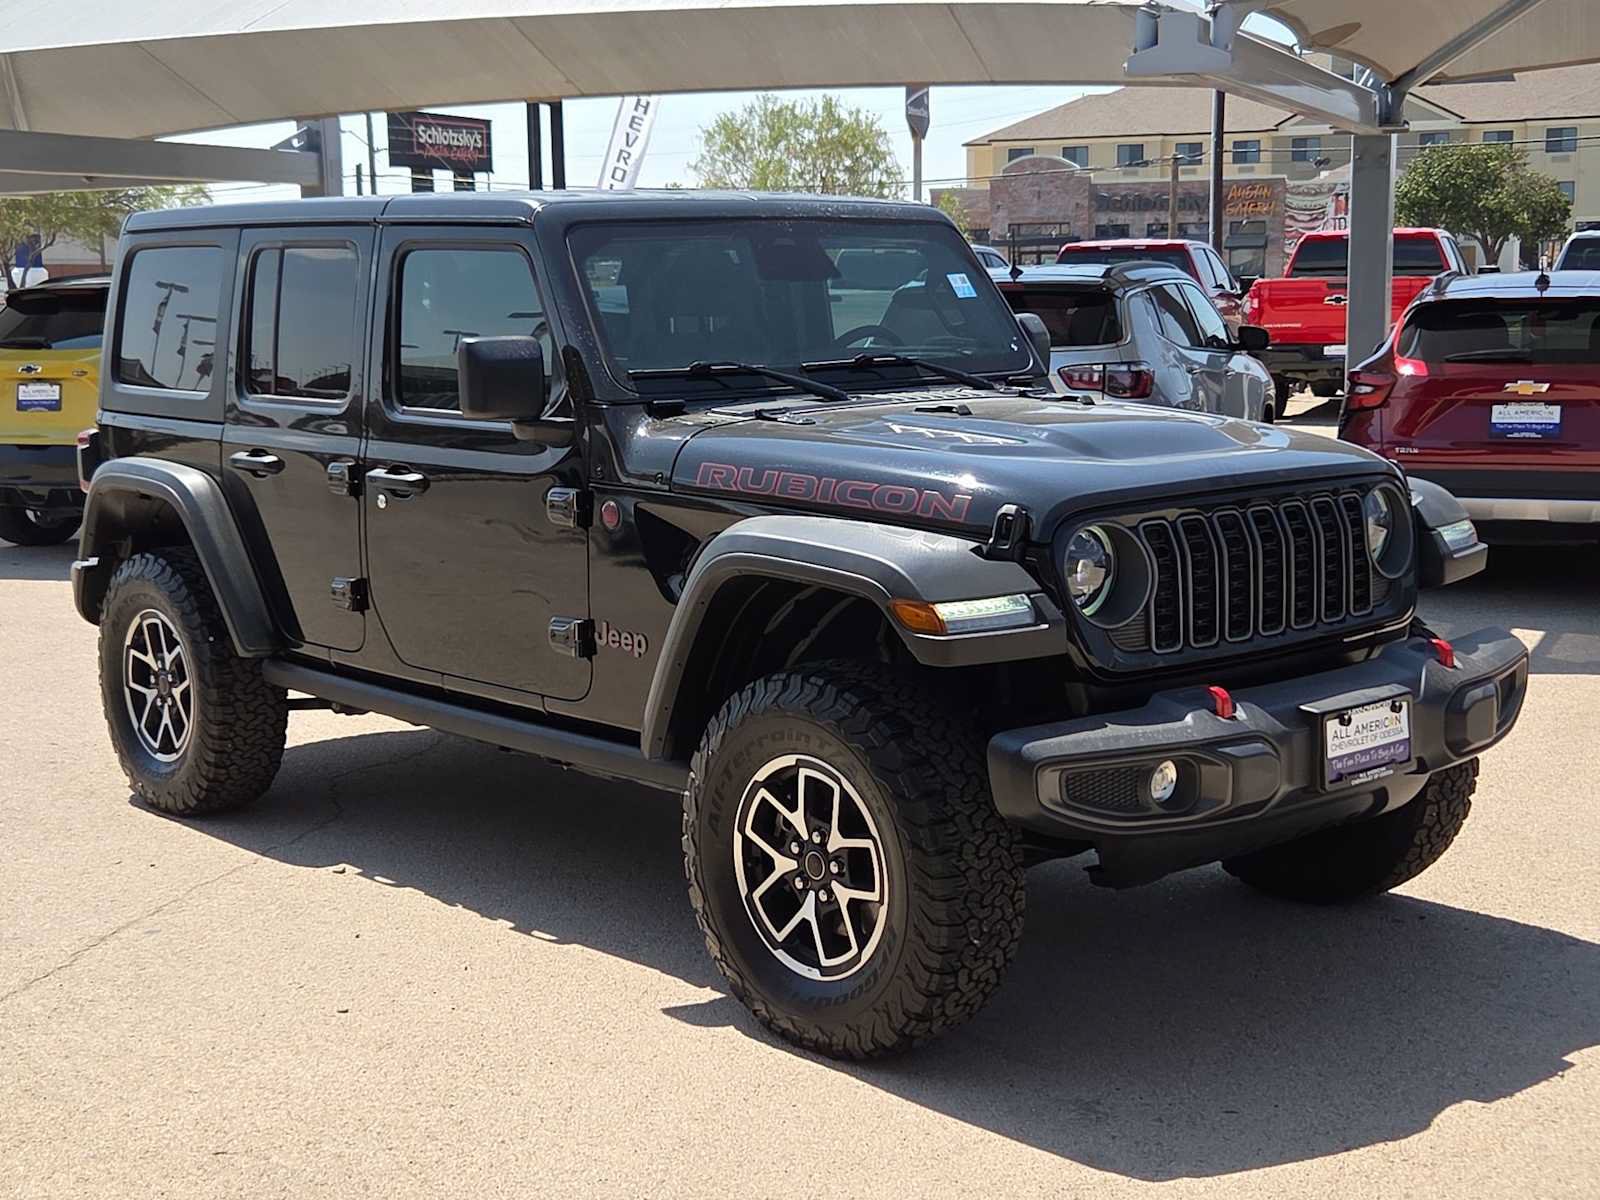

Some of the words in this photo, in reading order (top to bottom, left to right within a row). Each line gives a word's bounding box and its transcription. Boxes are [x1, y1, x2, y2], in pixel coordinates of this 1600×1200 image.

[417, 125, 482, 151] Schlotzsky's
[608, 97, 651, 190] HEVRO
[1228, 184, 1272, 200] AUSTIN
[1225, 201, 1275, 217] EATERY
[696, 462, 972, 522] RUBICON
[594, 620, 649, 659] Jeep
[1330, 735, 1369, 752] CHEVROLET
[1332, 728, 1351, 741] ALL
